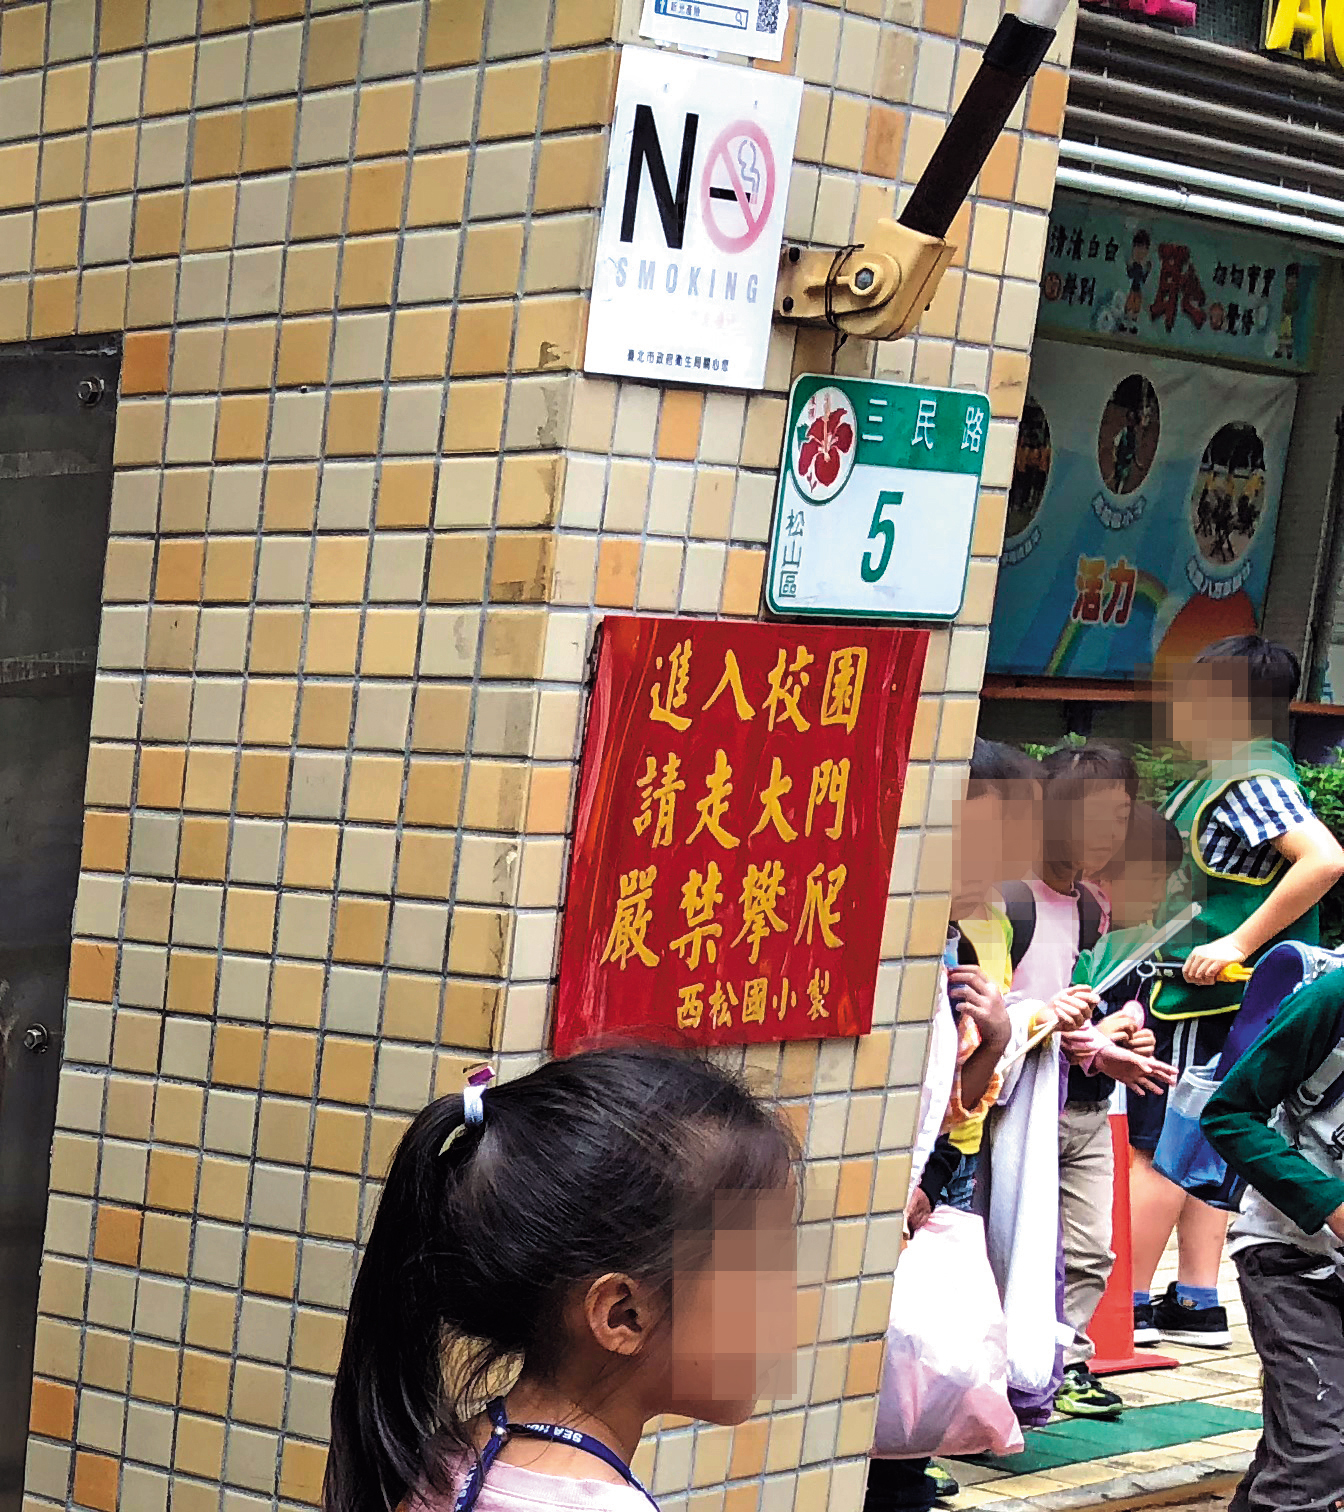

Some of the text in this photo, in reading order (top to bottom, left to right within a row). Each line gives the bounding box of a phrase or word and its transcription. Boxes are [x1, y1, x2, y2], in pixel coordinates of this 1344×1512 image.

[615, 256, 759, 304] SMOKING
[861, 397, 985, 454] 三民路
[778, 508, 806, 599] 松山區
[860, 490, 905, 583] 5
[1072, 553, 1138, 625] 活力
[648, 637, 870, 736] 進入校園
[631, 747, 852, 850] 請走大門
[599, 859, 848, 972] 嚴禁攀爬
[676, 967, 831, 1031] 西松國小製
